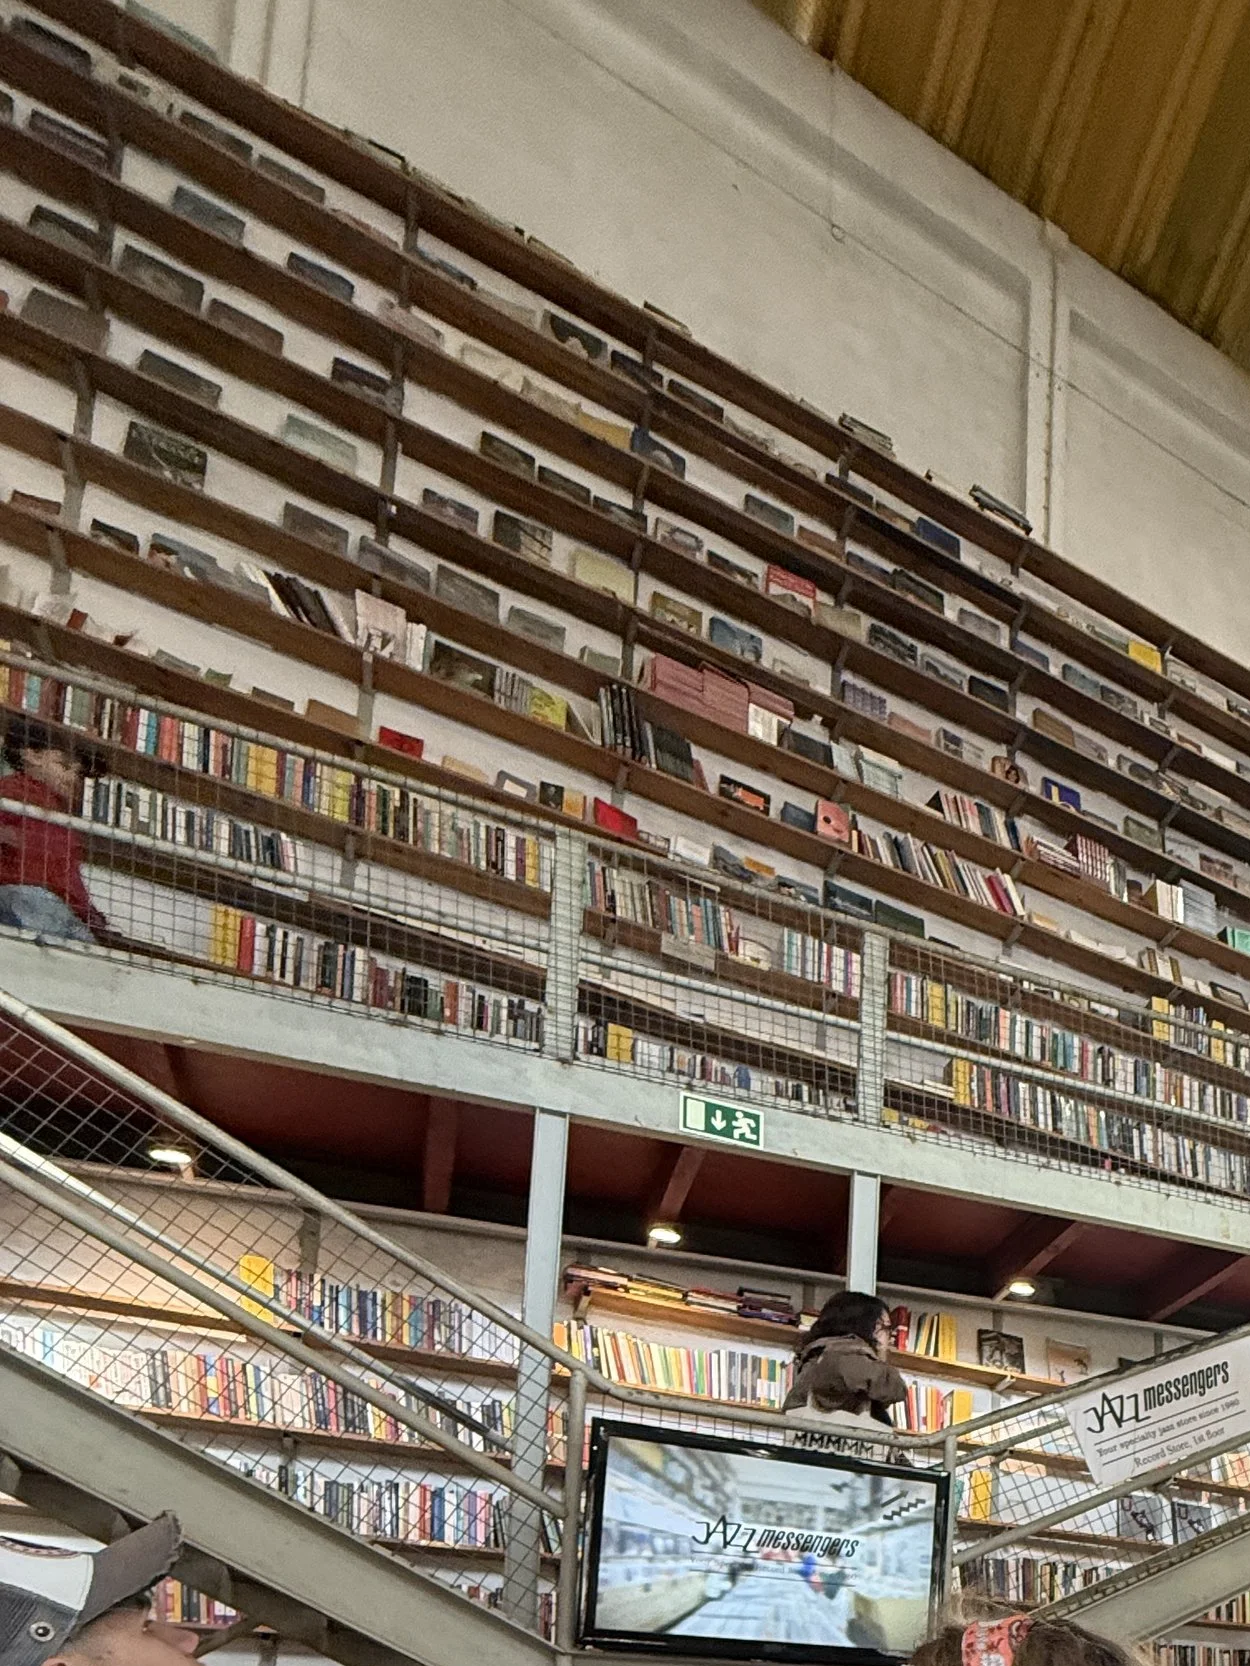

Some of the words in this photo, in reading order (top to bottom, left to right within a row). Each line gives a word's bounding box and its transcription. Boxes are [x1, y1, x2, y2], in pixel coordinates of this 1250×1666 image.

[1083, 1392, 1151, 1433] JAZZ
[1143, 1361, 1230, 1412] messengers
[1119, 1429, 1156, 1453] specialty
[1176, 1415, 1198, 1429] store
[1134, 1449, 1166, 1468] Record
[692, 1514, 760, 1553] JAZZ
[756, 1528, 860, 1558] messengers
